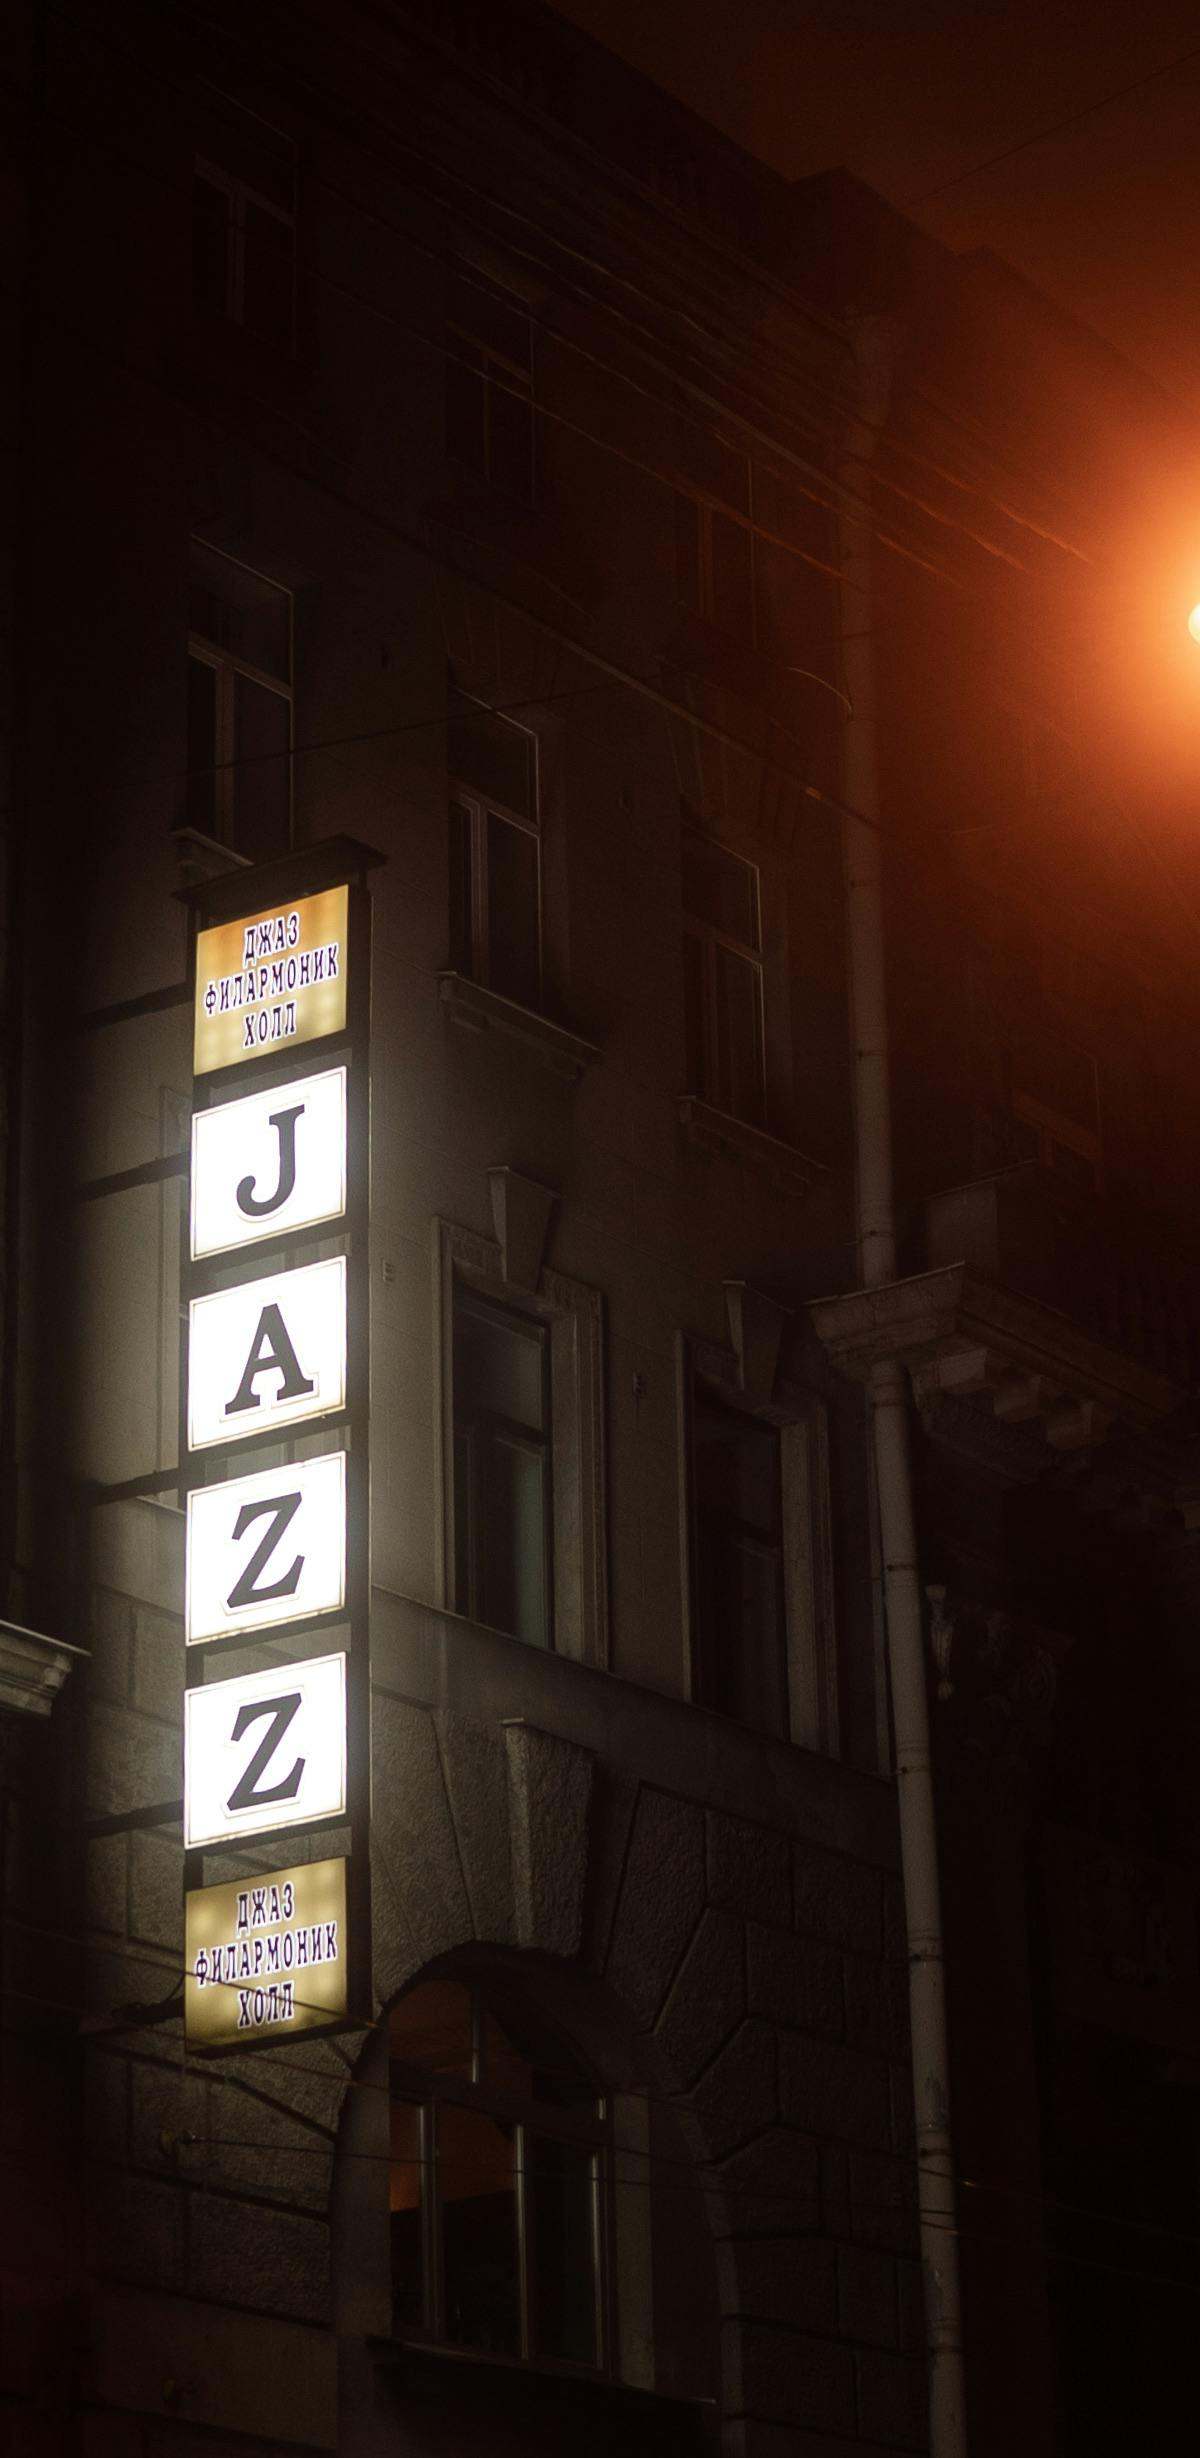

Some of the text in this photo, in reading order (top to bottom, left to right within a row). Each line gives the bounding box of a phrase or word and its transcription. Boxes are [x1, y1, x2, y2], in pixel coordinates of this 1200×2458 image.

[244, 914, 298, 966] ДЖАЗ
[205, 944, 338, 1015] ФИЛАРМОНИК
[244, 1002, 296, 1047] ХОЛЛ
[225, 1104, 314, 1811] JAZZ
[237, 1882, 294, 1934] ДЖАЗ
[195, 1922, 338, 1986] ФИЛАРМОНИК
[238, 1982, 294, 2029] ХОЛЛ
